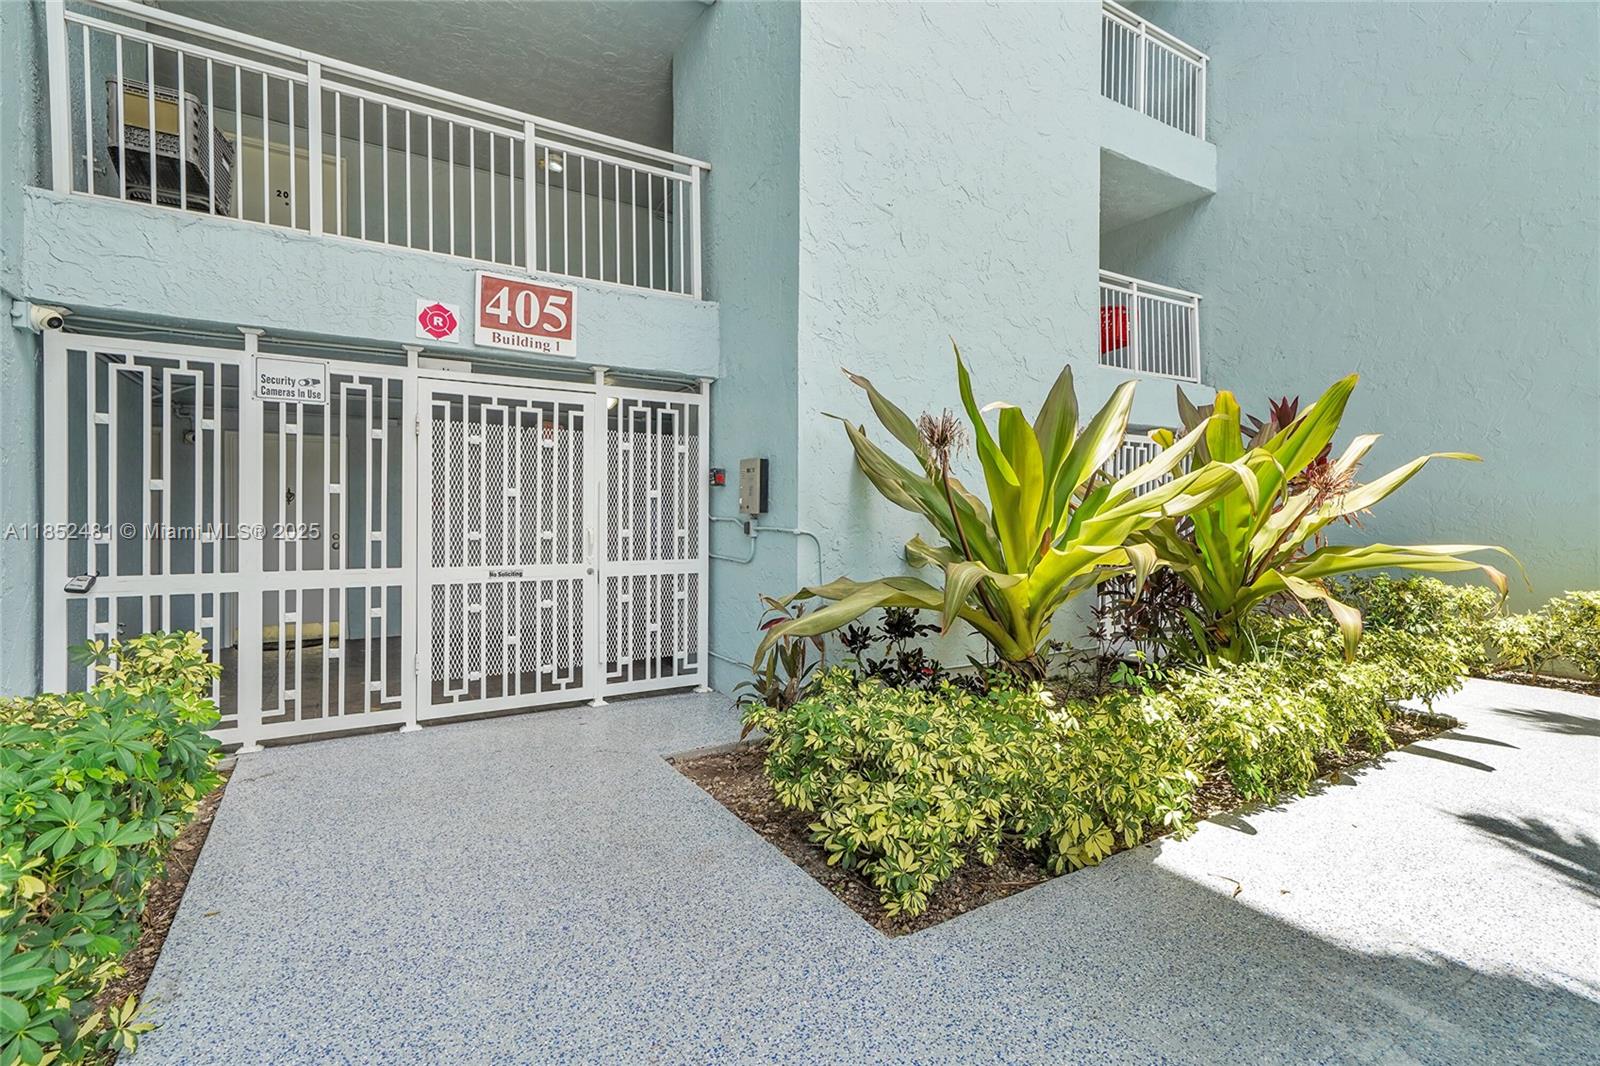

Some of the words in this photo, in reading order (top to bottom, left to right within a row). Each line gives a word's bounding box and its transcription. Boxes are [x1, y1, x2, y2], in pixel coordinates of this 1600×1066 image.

[485, 286, 568, 332] 405
[433, 316, 443, 327] R
[492, 331, 551, 353] Building
[556, 340, 561, 352] 1
[260, 373, 296, 388] Security
[260, 385, 296, 398] Cameras
[297, 388, 306, 399] In
[307, 389, 322, 400] Use
